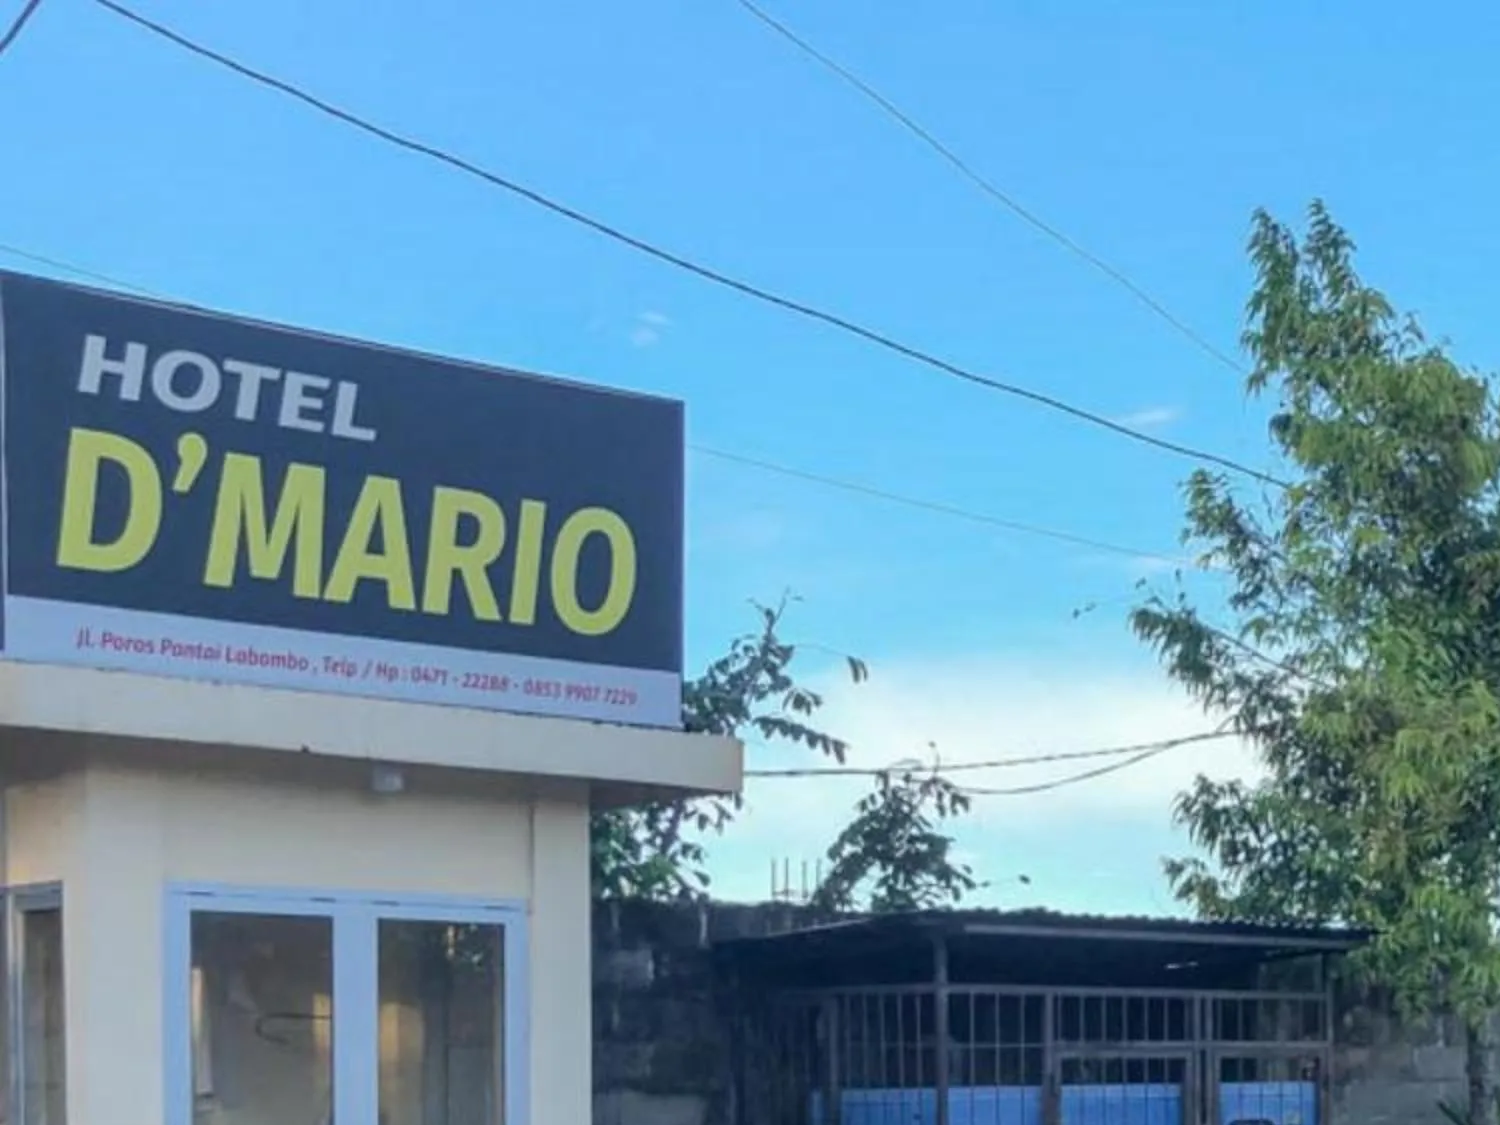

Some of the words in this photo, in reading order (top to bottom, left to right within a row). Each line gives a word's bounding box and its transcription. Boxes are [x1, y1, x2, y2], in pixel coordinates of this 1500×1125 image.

[77, 334, 376, 441] HOTEL
[56, 427, 637, 636] D'MARIO
[101, 631, 154, 654] Poros
[160, 638, 222, 661] Pantai
